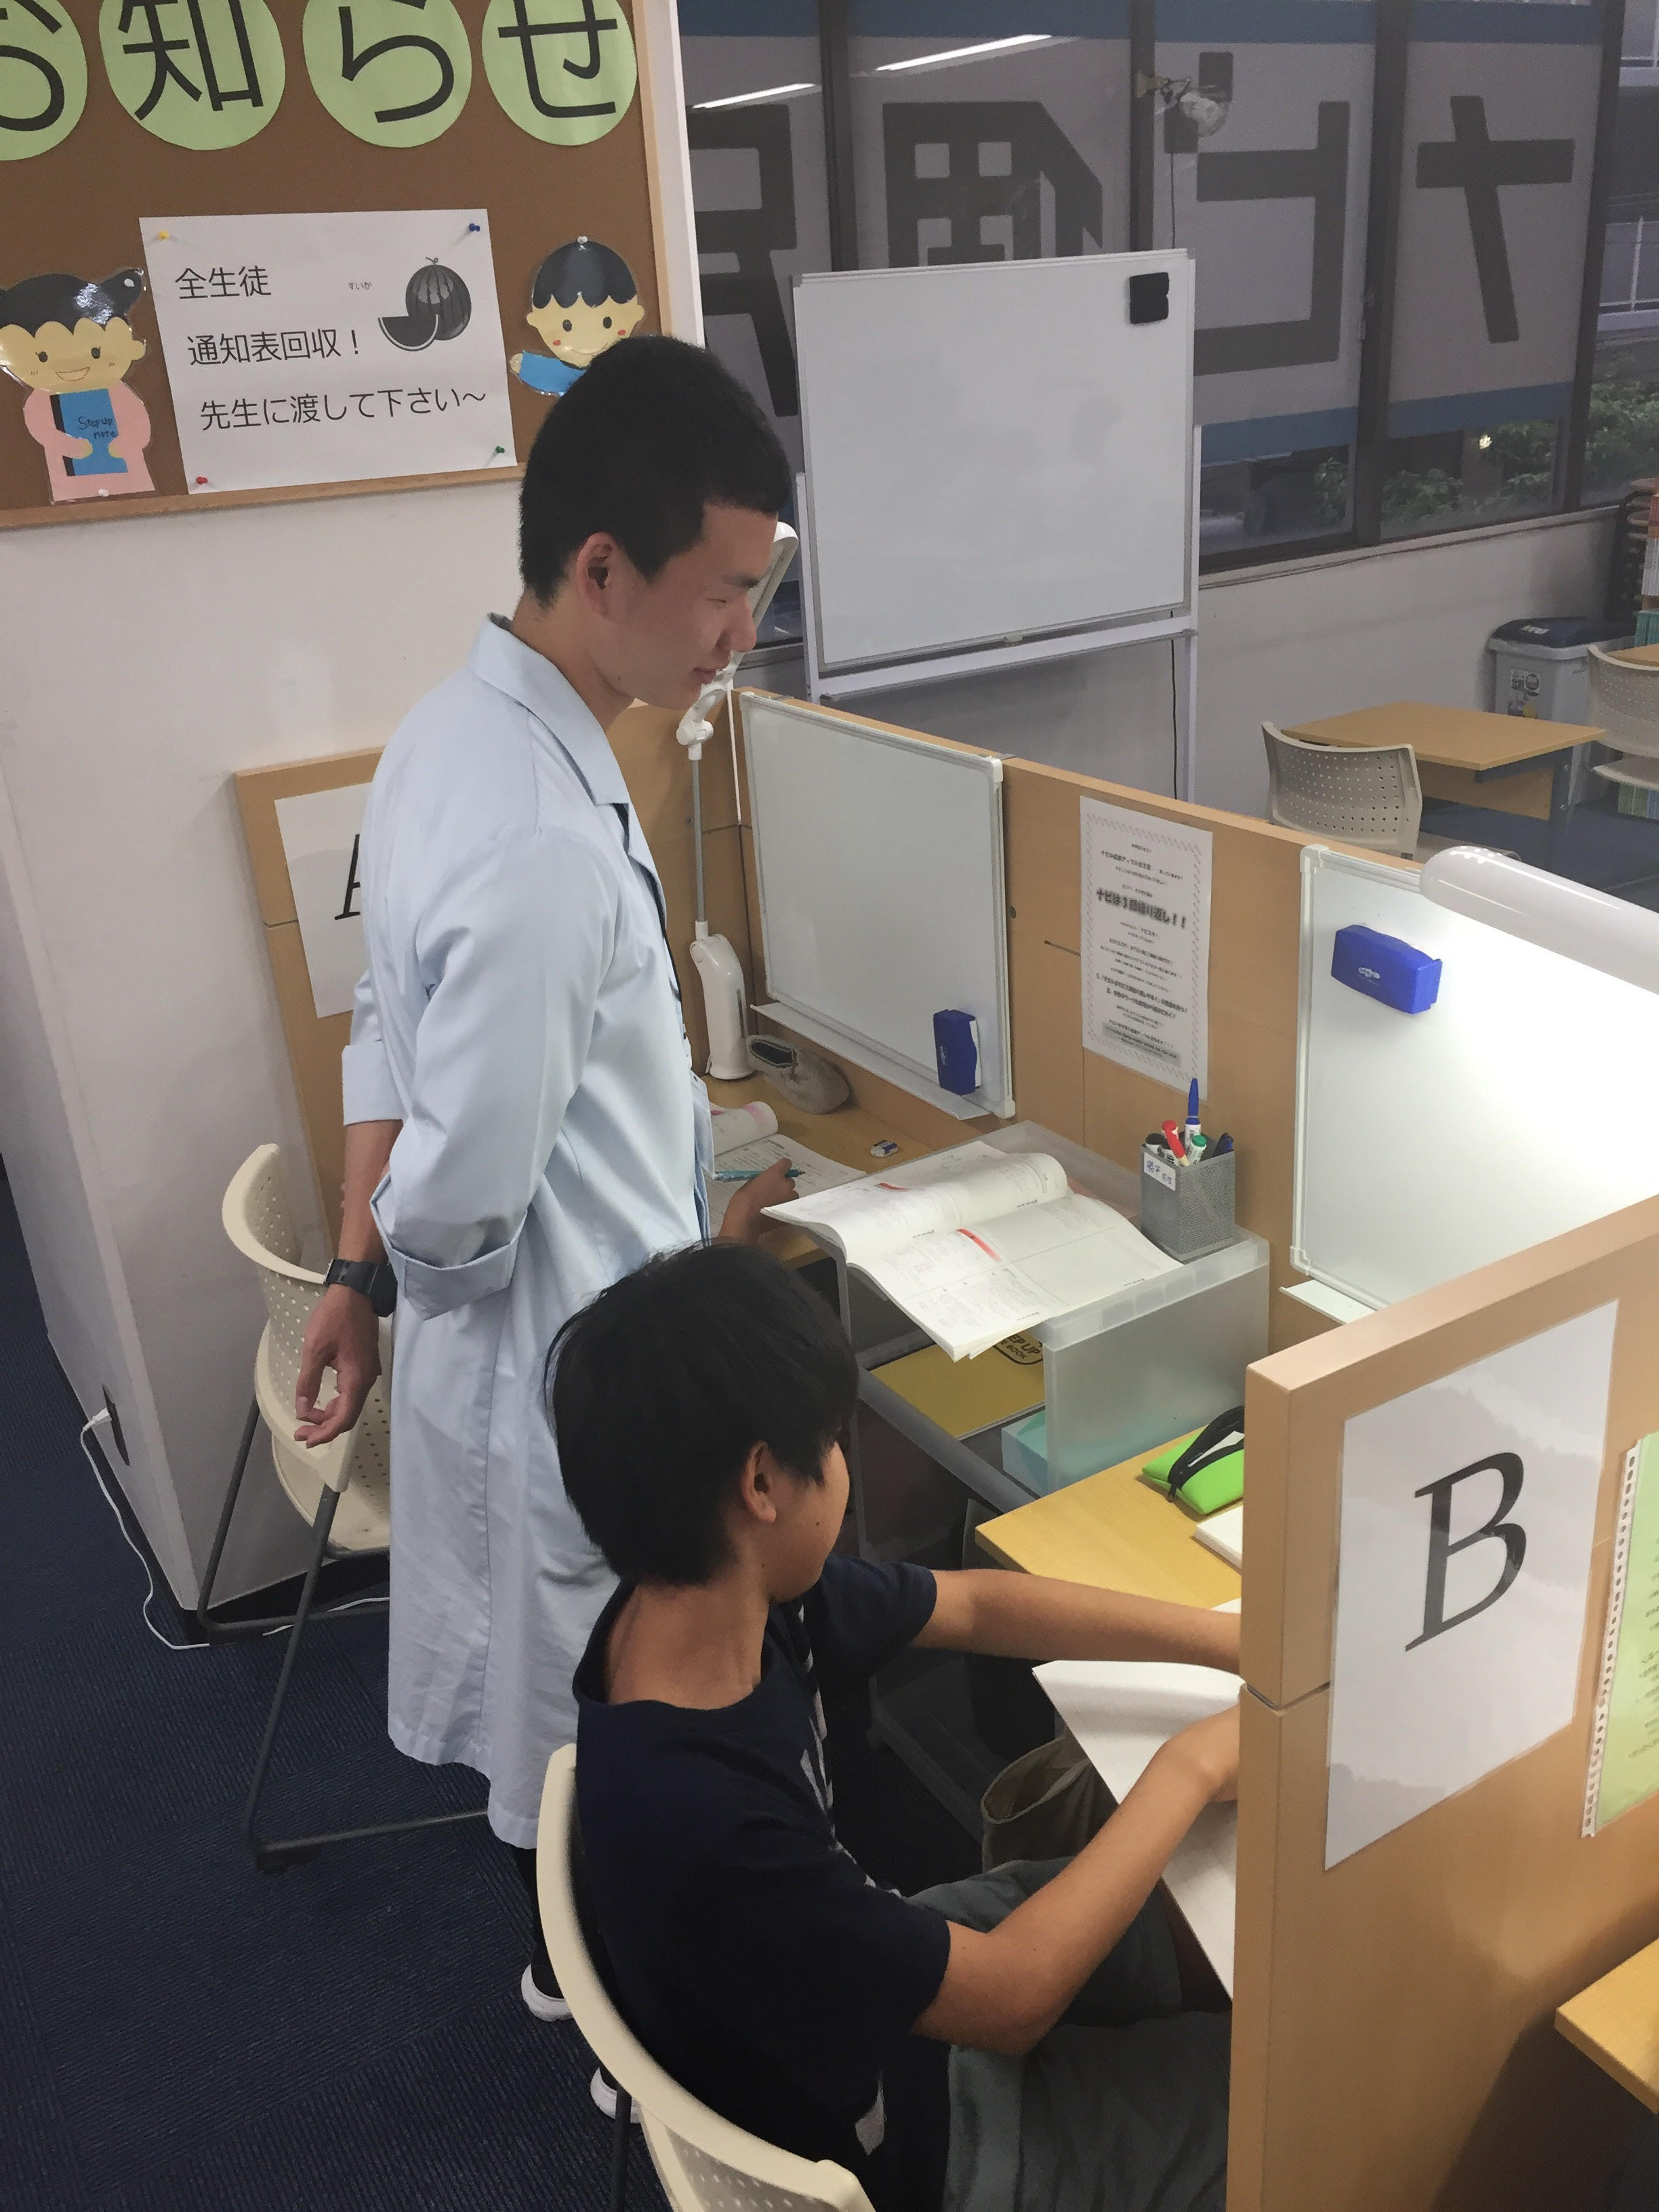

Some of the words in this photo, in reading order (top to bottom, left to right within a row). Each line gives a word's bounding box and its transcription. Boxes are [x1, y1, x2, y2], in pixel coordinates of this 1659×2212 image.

[175, 266, 272, 300] 全生徒
[348, 281, 373, 291] すいか
[188, 327, 362, 366] 通知表回収！
[1006, 1345, 1026, 1359] BOOK
[1021, 1343, 1040, 1354] UP
[1406, 1452, 1527, 1652] B
